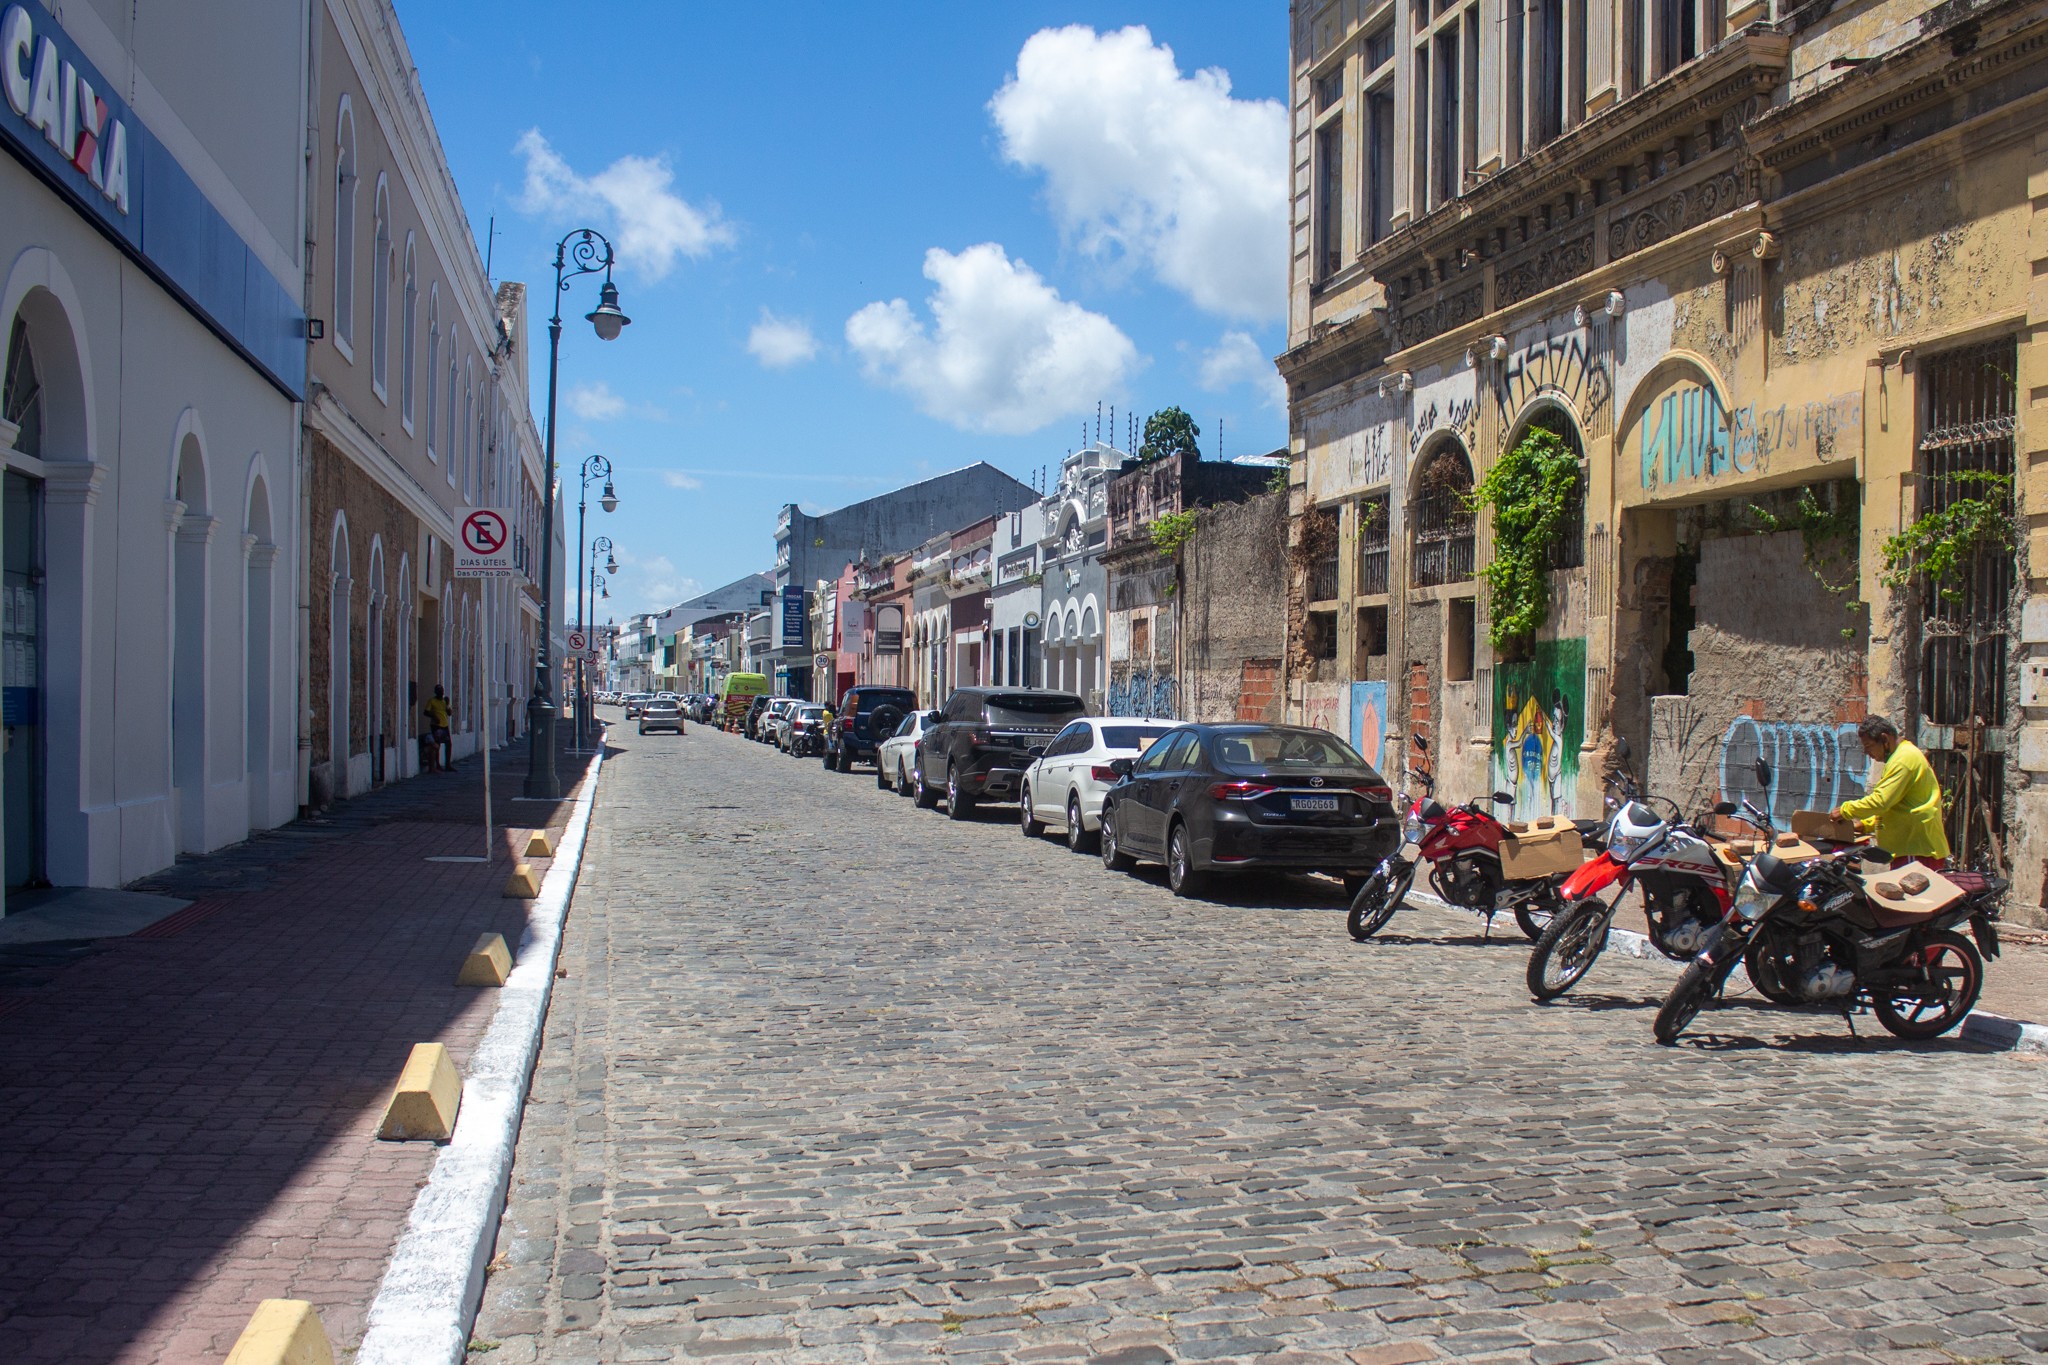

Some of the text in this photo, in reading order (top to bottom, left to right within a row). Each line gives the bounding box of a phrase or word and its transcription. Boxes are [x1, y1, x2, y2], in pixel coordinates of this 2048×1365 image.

[0, 3, 129, 215] CAIXA
[483, 557, 507, 566] ÚTEIS
[1635, 856, 1720, 874] BROS
